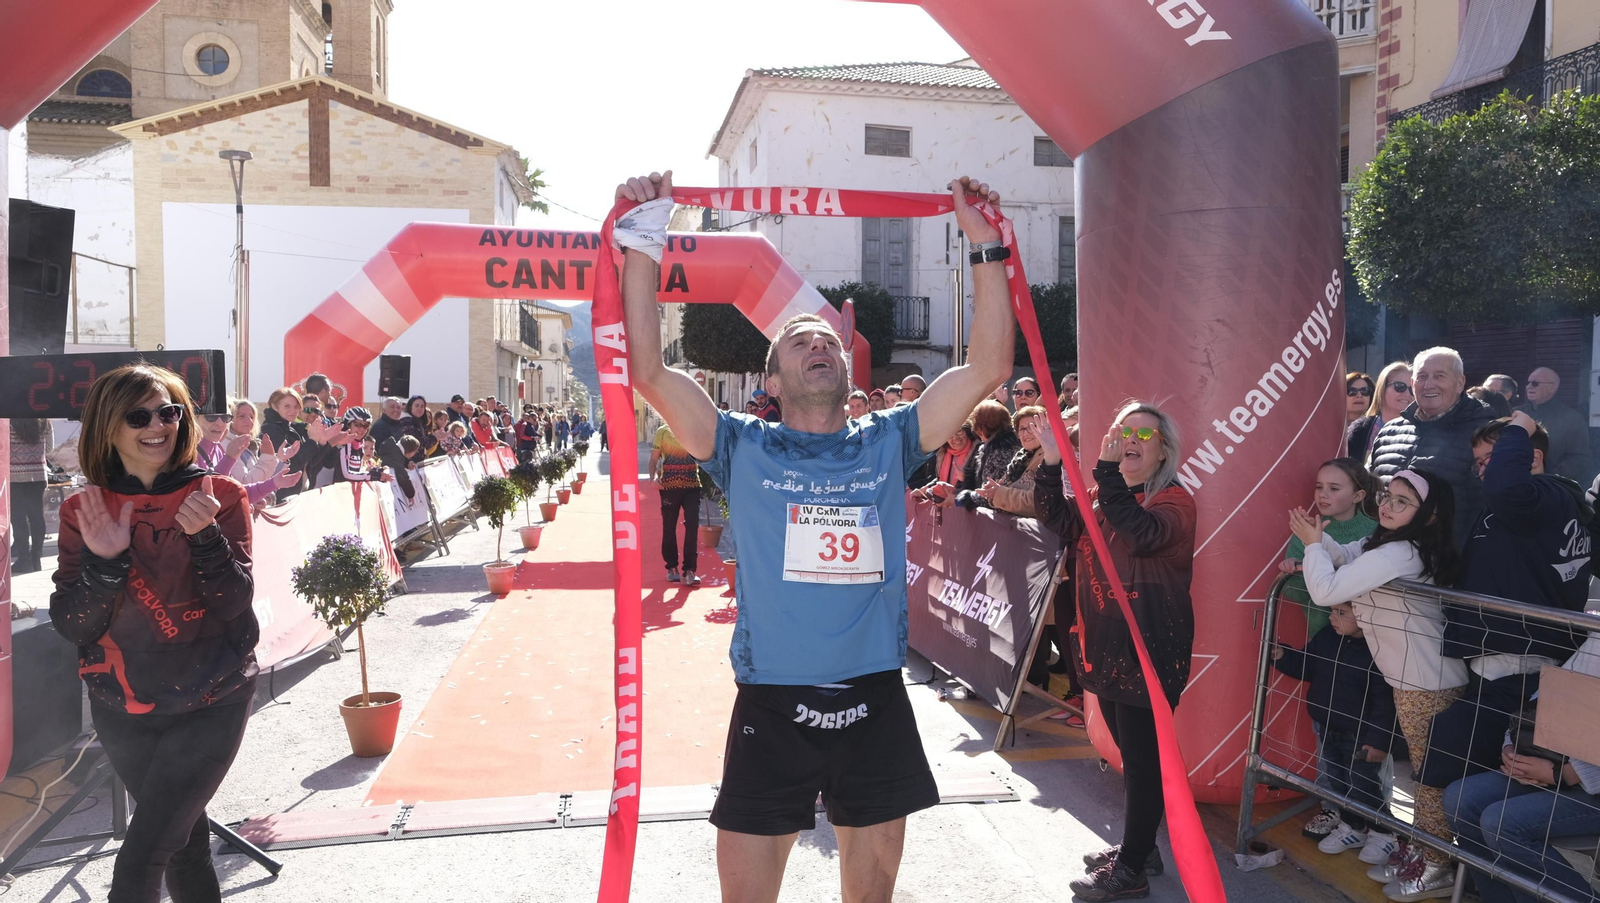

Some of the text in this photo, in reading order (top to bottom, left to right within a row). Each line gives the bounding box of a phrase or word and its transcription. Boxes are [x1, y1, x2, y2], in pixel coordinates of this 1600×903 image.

[594, 320, 629, 387] LA
[1176, 268, 1342, 496] ww.teamergy.es
[799, 516, 810, 525] LA
[813, 516, 857, 528] PÓLVORA
[802, 506, 813, 515] IV
[816, 506, 840, 516] CxM
[818, 531, 860, 563] 39
[938, 578, 1013, 630] TEAMERGY
